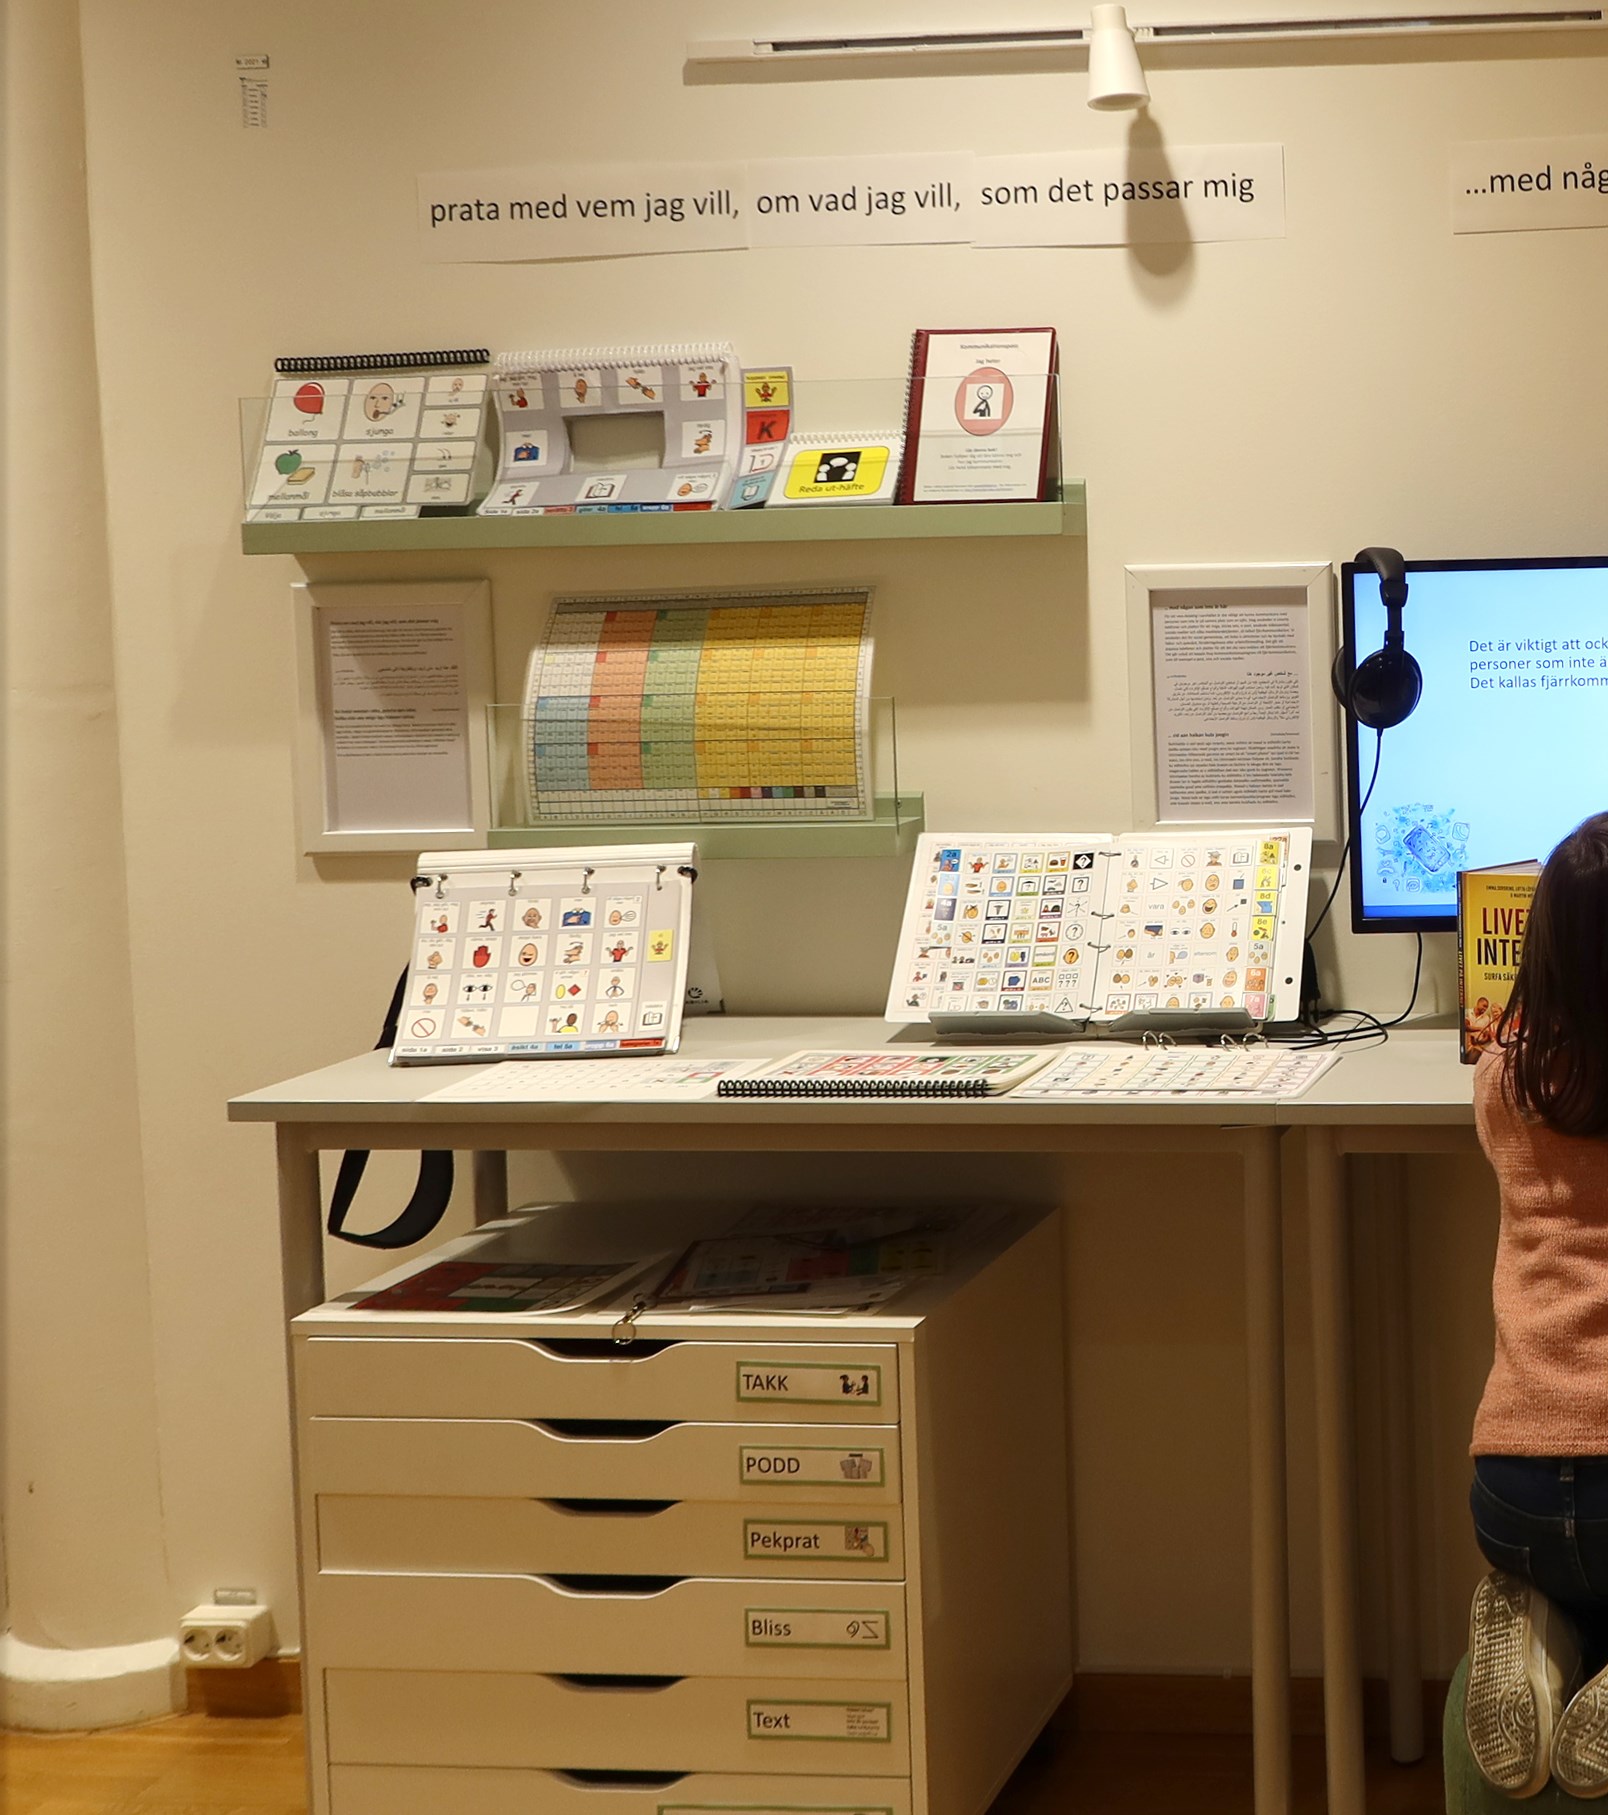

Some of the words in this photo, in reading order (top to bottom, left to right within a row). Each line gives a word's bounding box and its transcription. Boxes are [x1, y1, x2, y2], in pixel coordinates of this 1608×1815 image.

[431, 199, 499, 228] prata
[510, 193, 567, 220] med
[576, 199, 635, 218] vem
[644, 193, 685, 223] jag
[693, 190, 738, 219] vill,
[757, 195, 799, 214] om
[808, 186, 856, 212] vad
[865, 186, 906, 215] jag
[914, 182, 960, 211] vill,
[981, 186, 1037, 205] som
[1049, 177, 1093, 203] det
[1104, 180, 1193, 207] passar
[1204, 173, 1254, 203] mig
[288, 429, 318, 438] ballong
[365, 428, 394, 437] sjunga
[757, 421, 776, 440] K
[798, 485, 823, 494] Reda
[1469, 640, 1493, 652] Det
[1498, 640, 1511, 651] är
[1515, 638, 1557, 653] viktigt
[1562, 639, 1581, 650] att
[1470, 660, 1531, 673] personer
[1536, 659, 1564, 669] som
[1569, 656, 1595, 668] inte
[1470, 677, 1494, 689] Det
[1499, 676, 1536, 688] kallas
[1148, 903, 1165, 911] vara
[1477, 938, 1521, 967] INTE
[1032, 976, 1050, 984] ABC
[1484, 972, 1502, 981] SURFA
[1503, 971, 1516, 981] SÄK
[742, 1374, 788, 1391] TAKK
[746, 1457, 800, 1473] PODD
[751, 1532, 820, 1551] Pekprat
[752, 1619, 791, 1636] Bliss
[753, 1712, 790, 1728] Text
